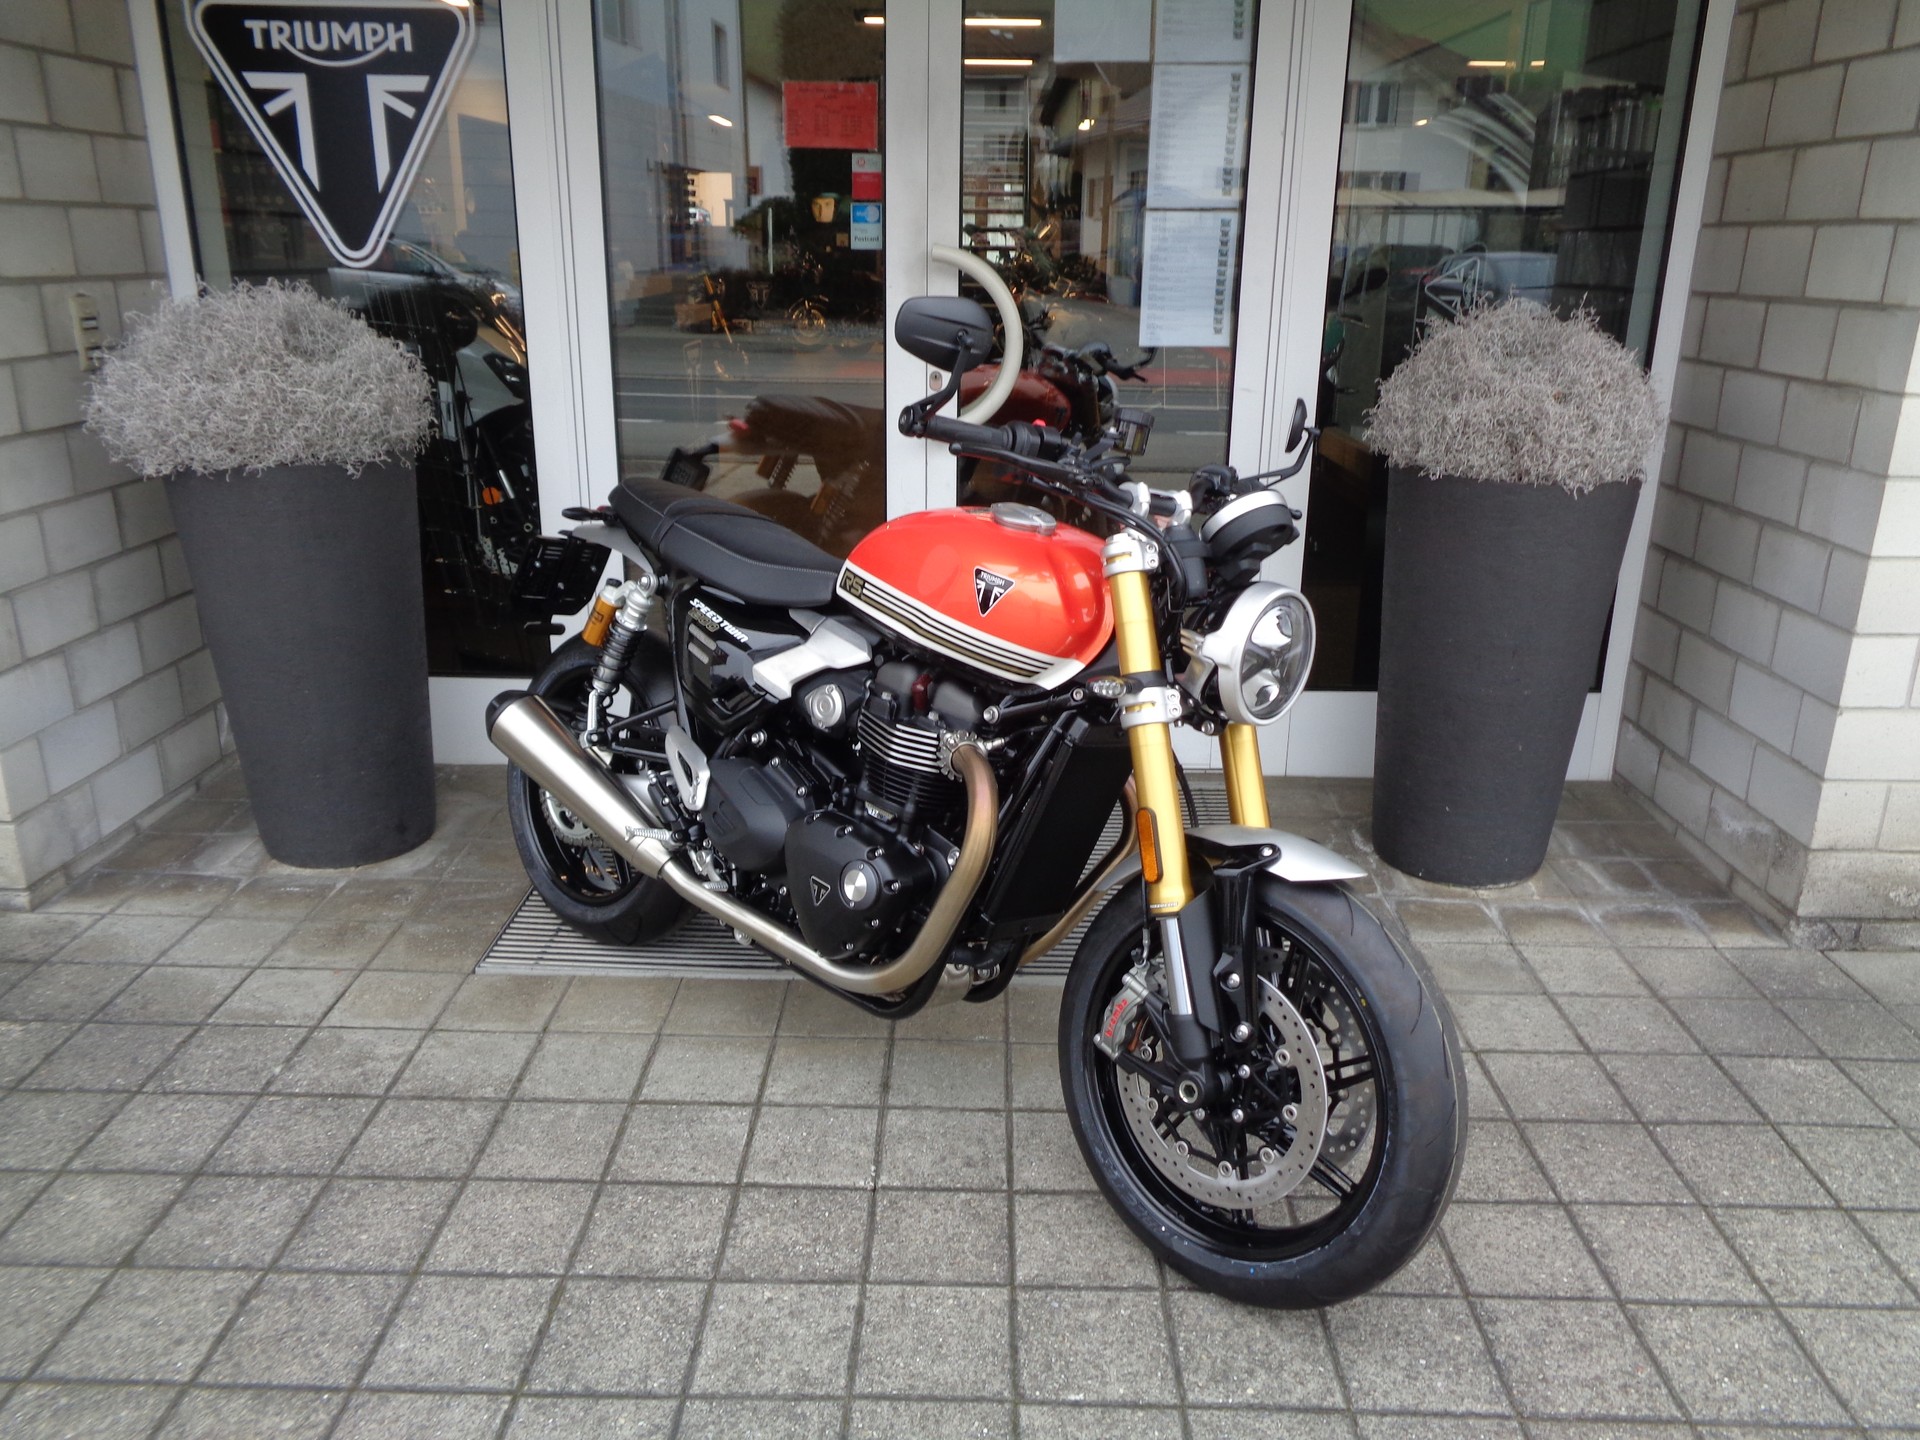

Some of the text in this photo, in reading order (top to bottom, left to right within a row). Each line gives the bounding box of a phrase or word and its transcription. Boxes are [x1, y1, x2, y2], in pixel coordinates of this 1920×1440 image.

[244, 19, 412, 64] TRIUMPH
[841, 570, 864, 597] RS
[980, 571, 1005, 586] TRIUMPH
[690, 598, 723, 623] SPEED
